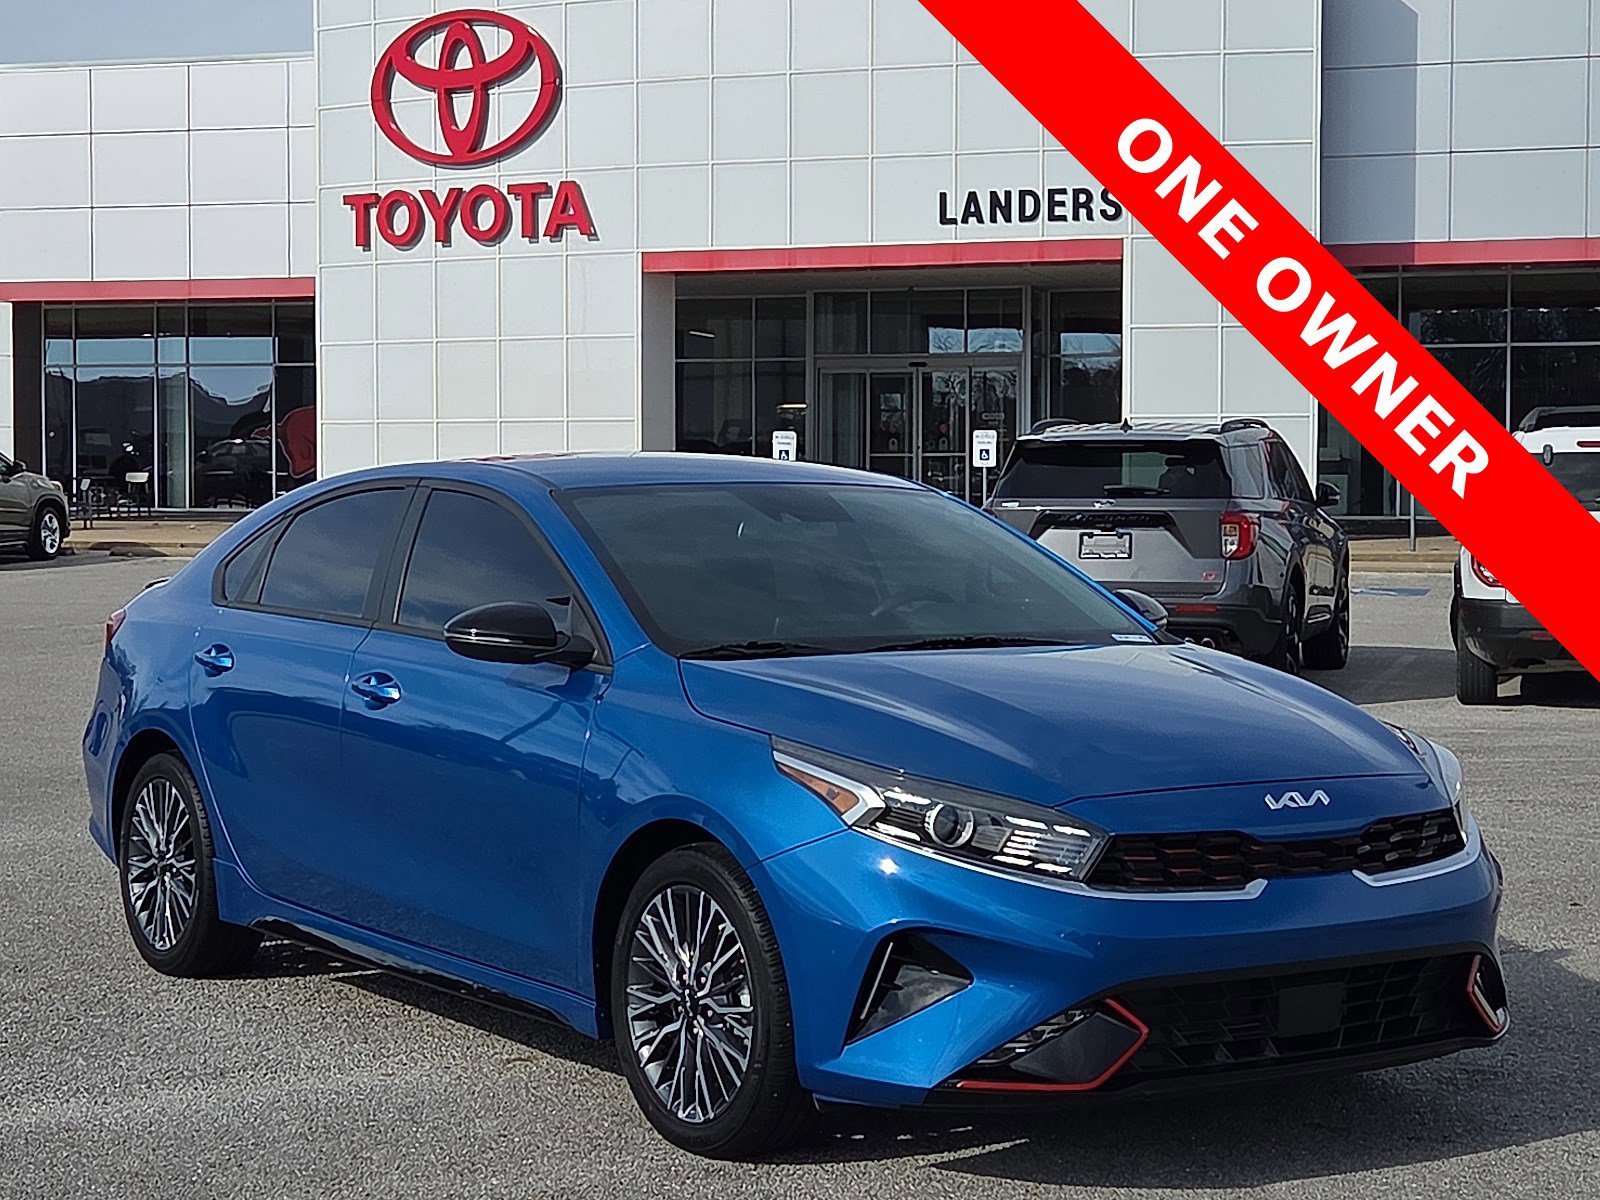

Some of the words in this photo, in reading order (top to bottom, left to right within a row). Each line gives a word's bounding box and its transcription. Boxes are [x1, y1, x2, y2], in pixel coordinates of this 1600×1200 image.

[343, 181, 597, 249] TOYOTA
[939, 188, 1122, 225] LANDERS
[1264, 789, 1330, 809] KIA
